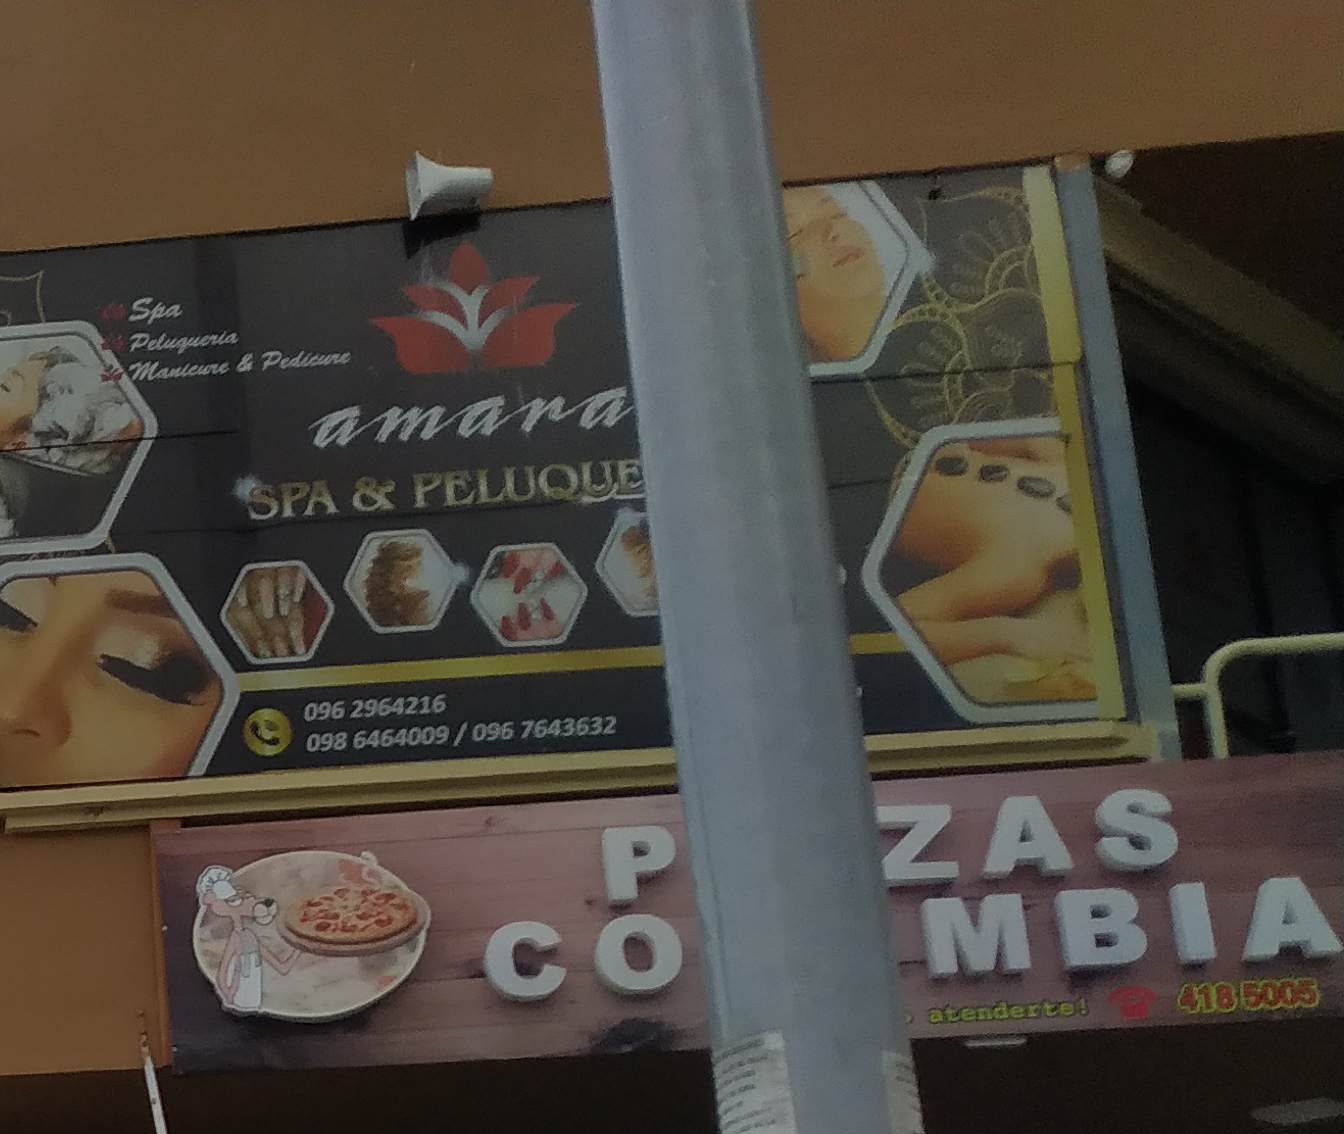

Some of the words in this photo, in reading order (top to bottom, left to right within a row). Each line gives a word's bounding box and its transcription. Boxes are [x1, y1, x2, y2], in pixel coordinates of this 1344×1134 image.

[129, 297, 183, 324] Spa
[128, 360, 230, 381] Manicure
[236, 353, 254, 373] &
[261, 350, 352, 370] Pedicure
[246, 479, 340, 520] SPA
[352, 476, 395, 511] &
[413, 459, 645, 509] PELUQUE
[303, 701, 346, 722] 096
[349, 693, 447, 719] 2964216
[306, 731, 347, 753] 098
[353, 725, 450, 749] 6464009
[453, 721, 467, 747] /
[472, 720, 515, 742] 096
[520, 716, 618, 741] 7643632
[602, 789, 1180, 908] PZAS
[485, 877, 1343, 1000] COMBIA
[927, 997, 1089, 1024] atenderte!
[1177, 981, 1238, 1015] 418
[1240, 976, 1322, 1010] 5005
